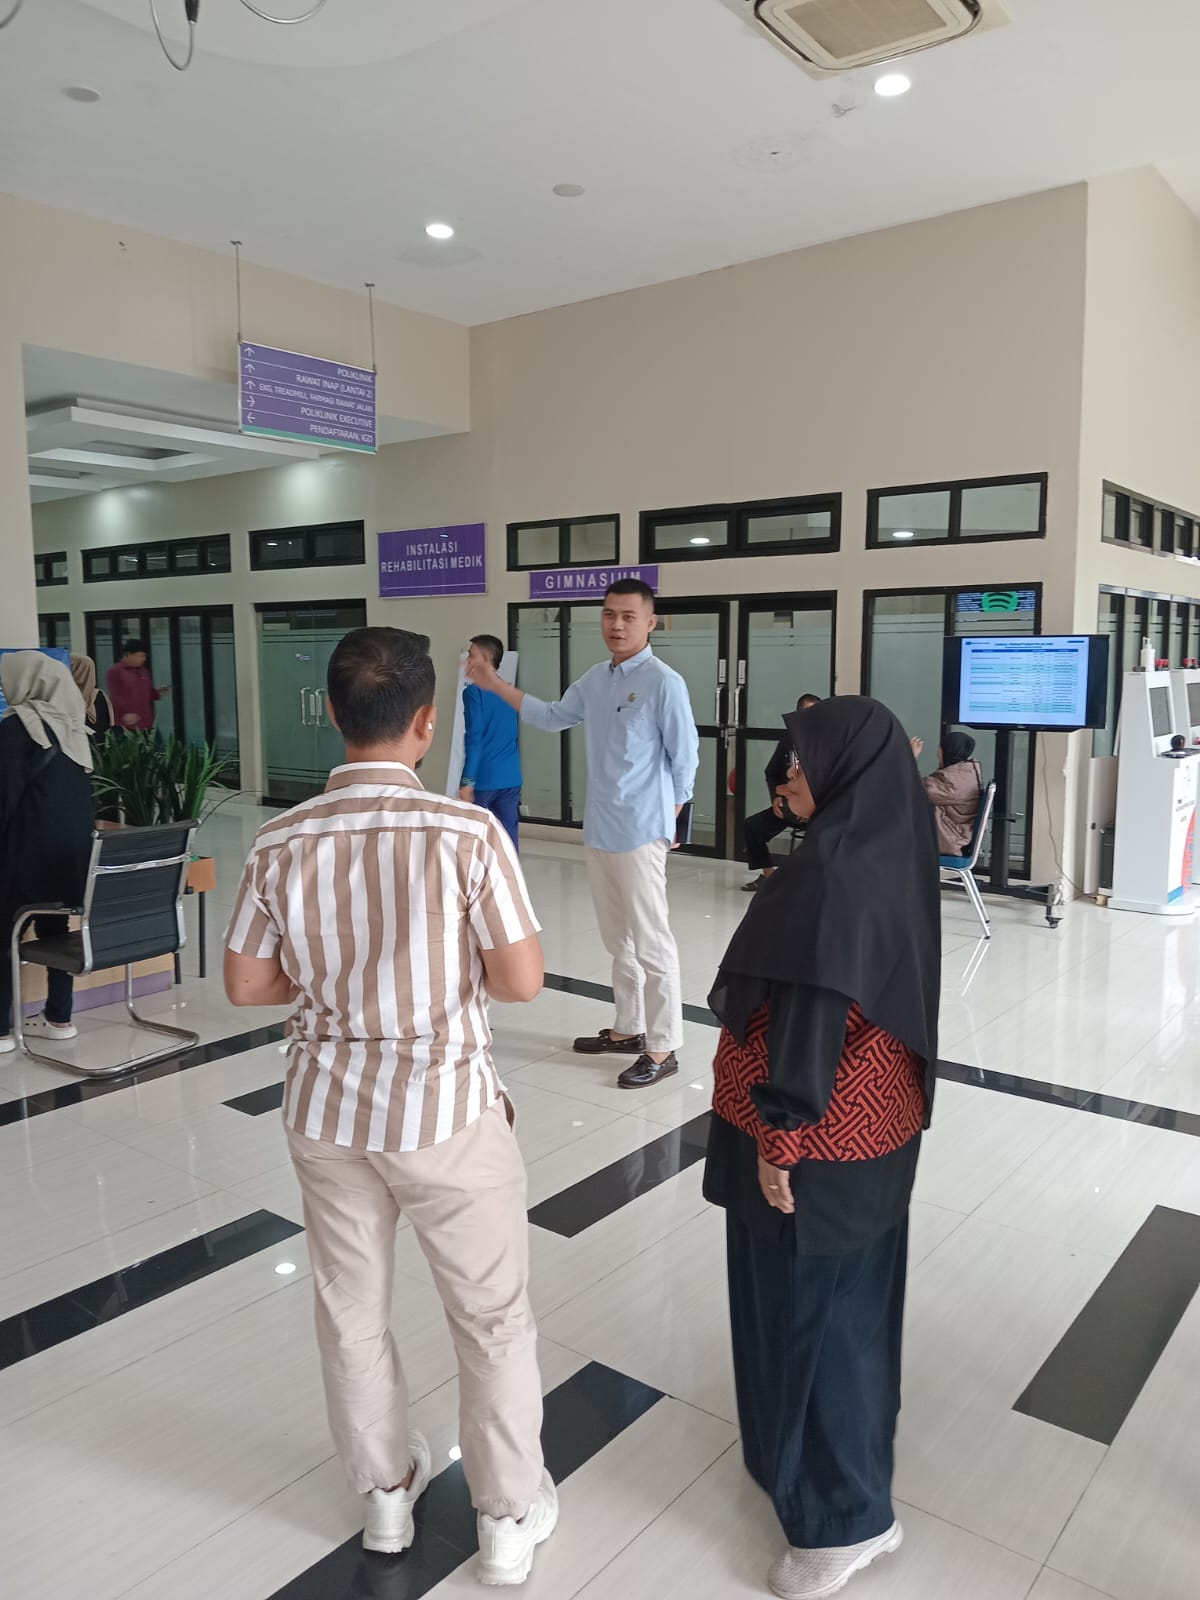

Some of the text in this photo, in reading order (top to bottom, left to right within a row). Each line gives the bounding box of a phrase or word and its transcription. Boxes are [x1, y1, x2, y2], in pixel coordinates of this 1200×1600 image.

[296, 374, 321, 386] RAWAT
[322, 380, 339, 390] INAP
[339, 414, 373, 428] EXECUTIVE
[406, 541, 458, 556] INSTALASI
[381, 555, 483, 573] REHABILITASI MEDIK
